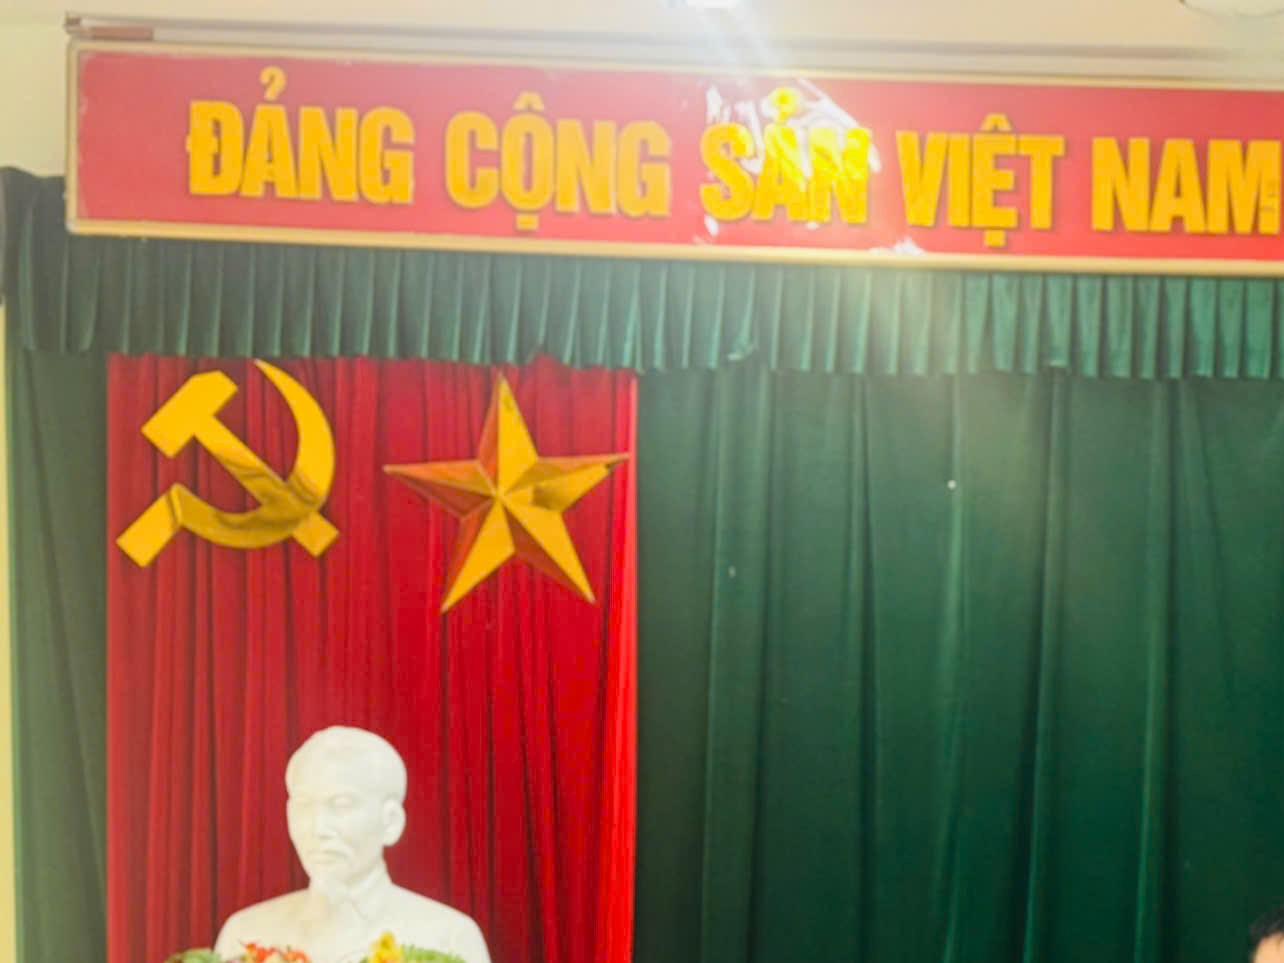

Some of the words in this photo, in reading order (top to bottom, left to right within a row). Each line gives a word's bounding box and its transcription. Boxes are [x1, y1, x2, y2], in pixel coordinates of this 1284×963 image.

[186, 67, 414, 205] ĐẢNG
[446, 93, 670, 230] CỘNG
[700, 87, 873, 224] SẢN
[896, 114, 1064, 246] VIỆT
[1092, 138, 1281, 235] NAM
